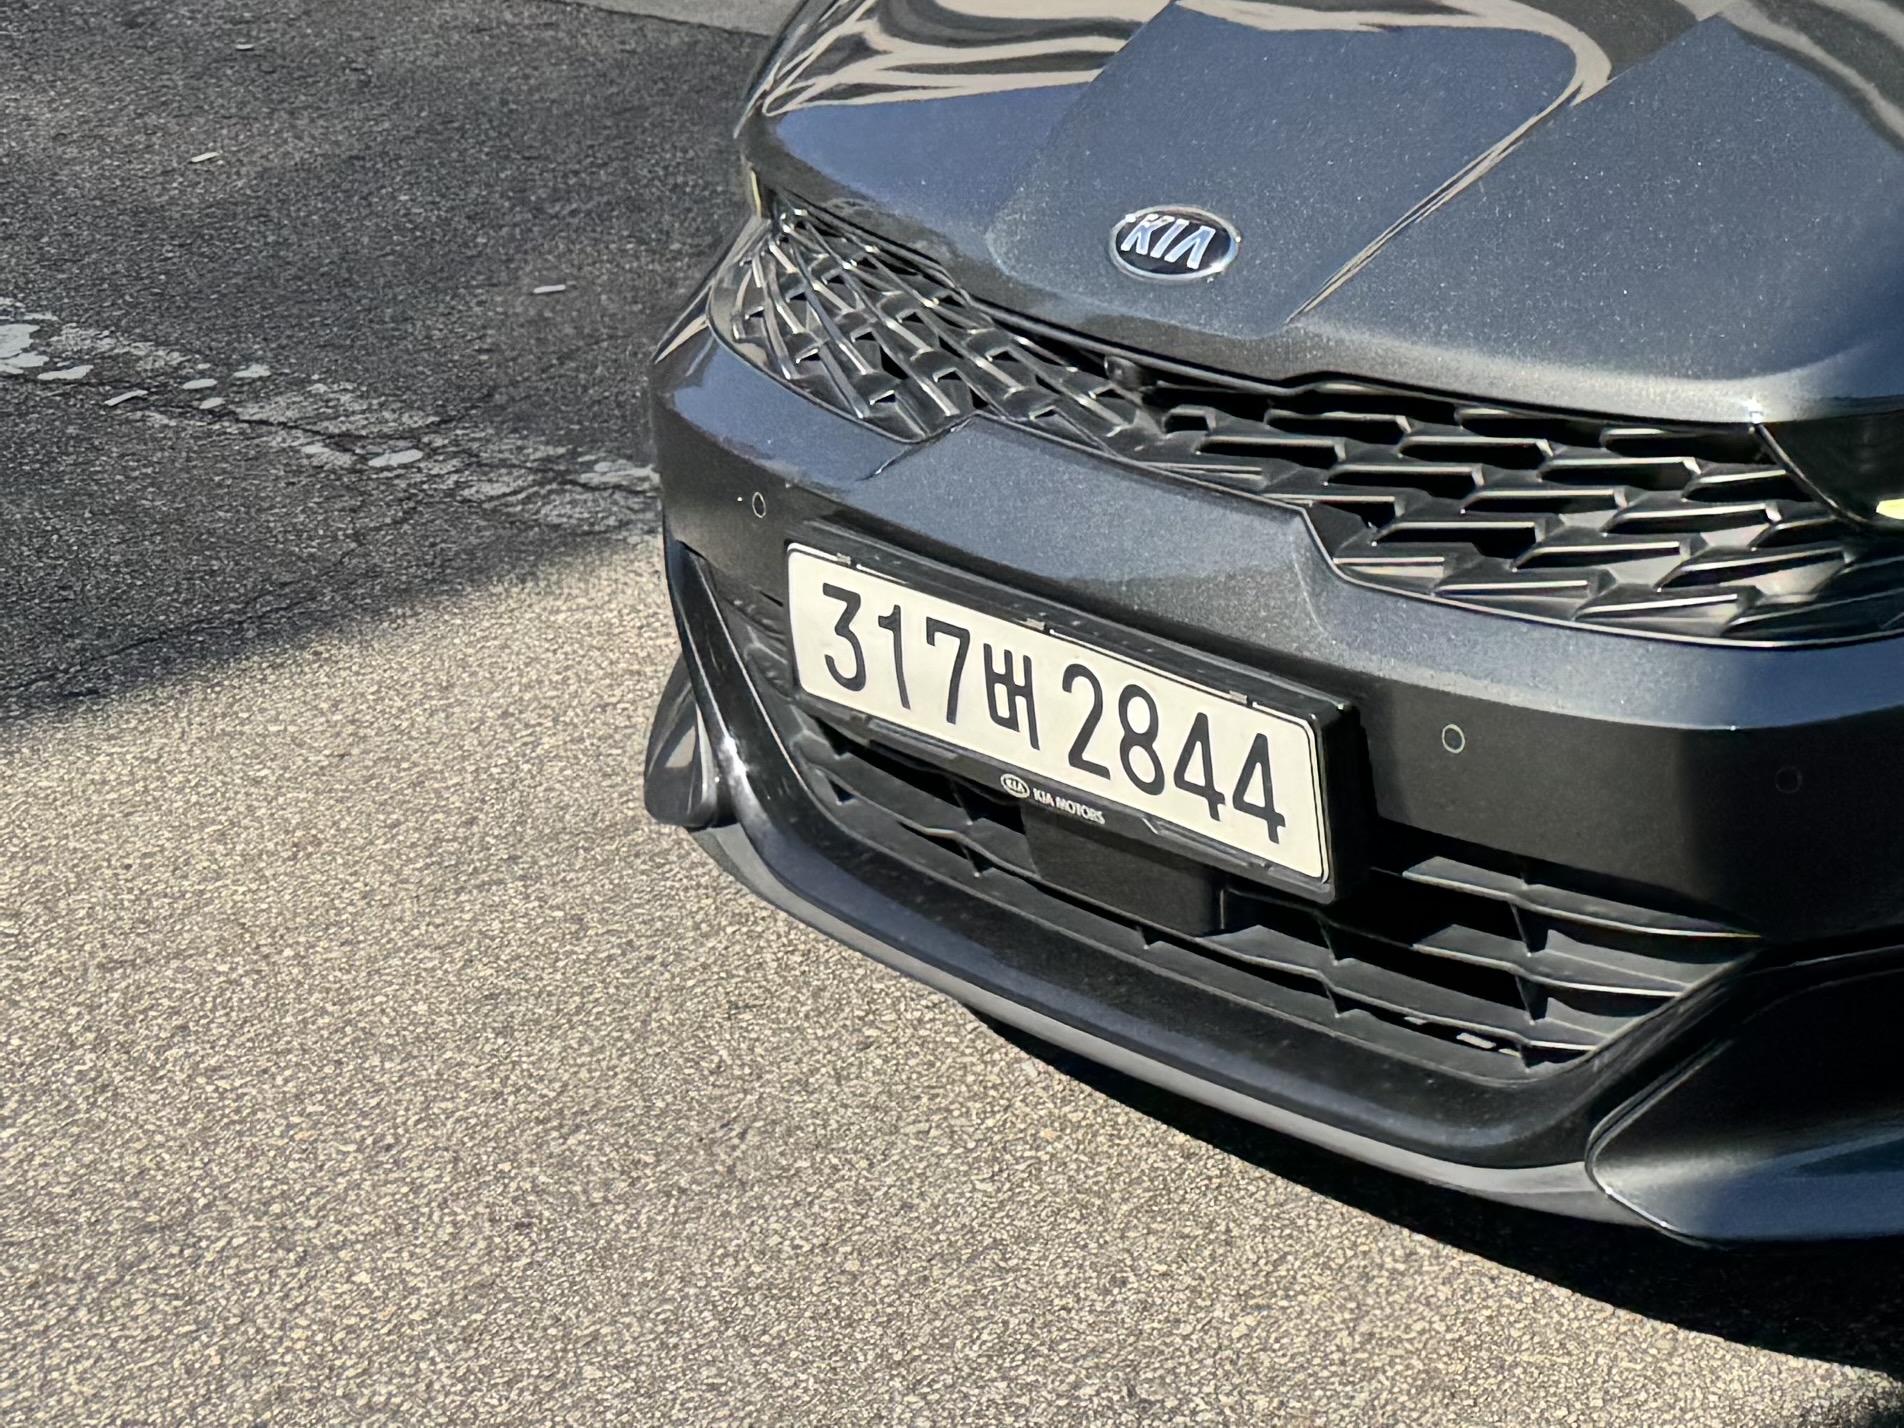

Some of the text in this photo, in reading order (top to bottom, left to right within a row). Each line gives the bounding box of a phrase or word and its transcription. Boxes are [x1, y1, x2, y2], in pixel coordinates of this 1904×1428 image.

[1120, 213, 1217, 271] KIA
[1061, 661, 1288, 846] 2844
[1033, 788, 1056, 808] KIA
[1055, 796, 1106, 826] MOTORS
